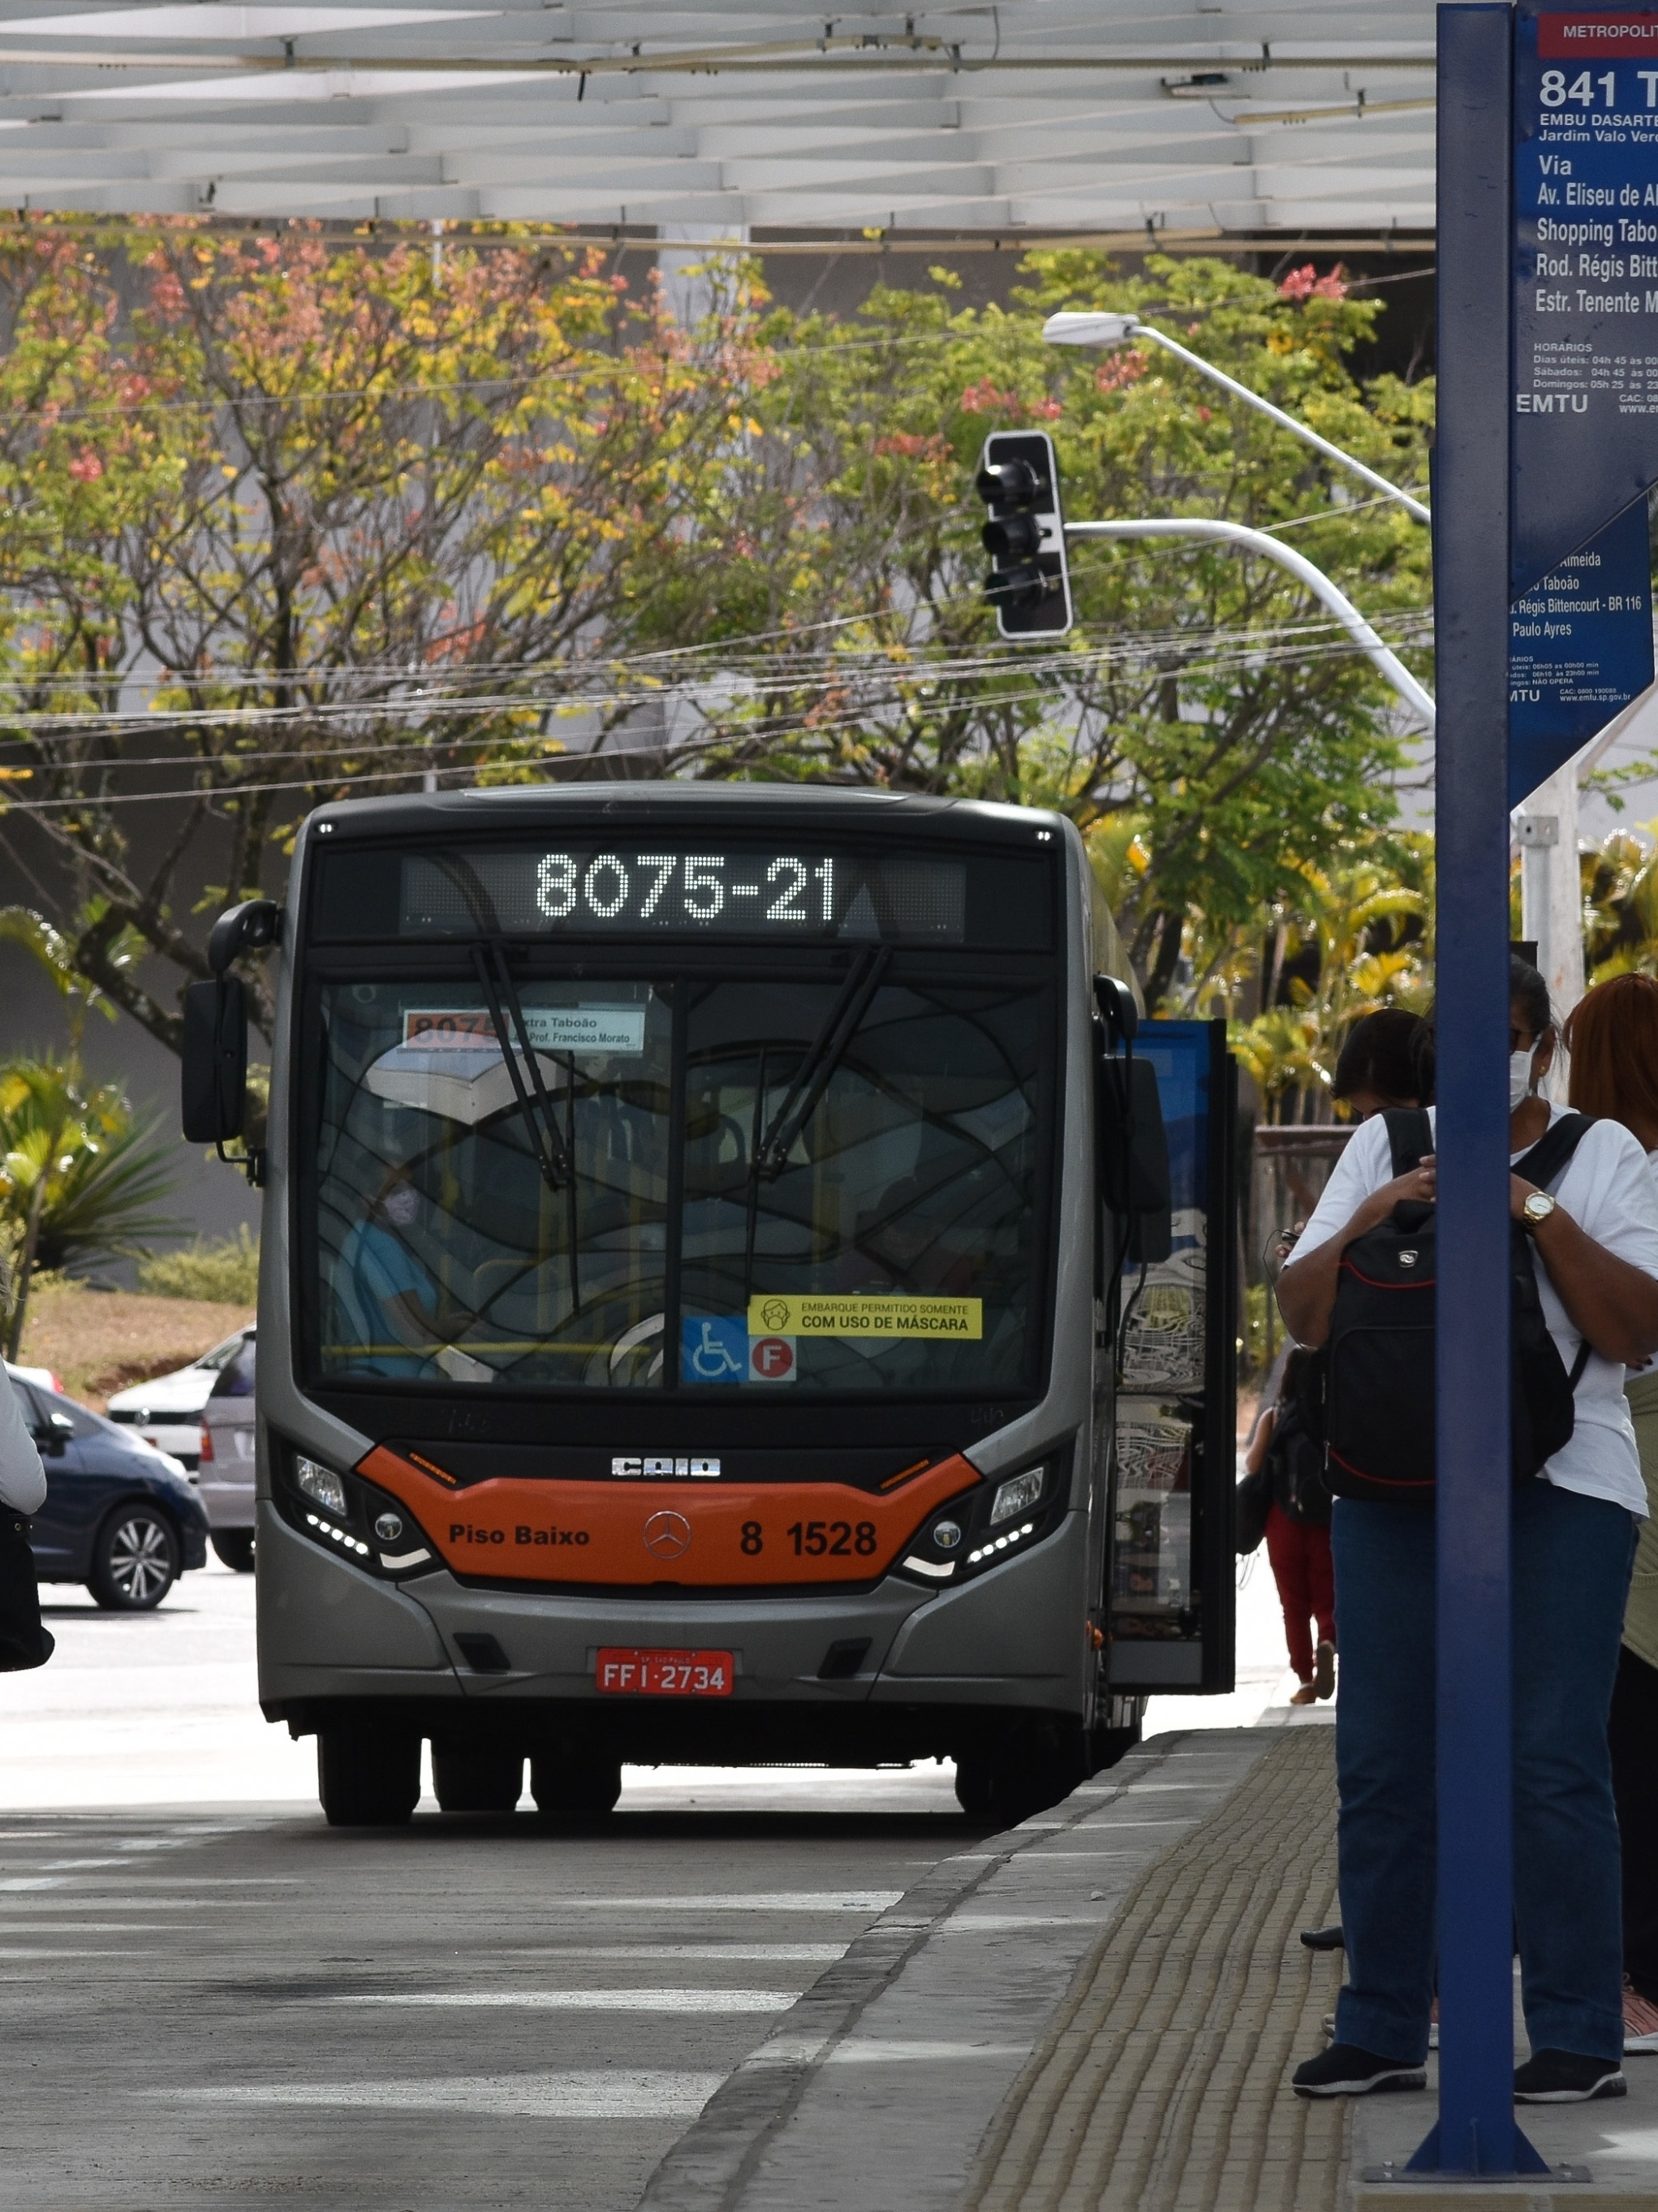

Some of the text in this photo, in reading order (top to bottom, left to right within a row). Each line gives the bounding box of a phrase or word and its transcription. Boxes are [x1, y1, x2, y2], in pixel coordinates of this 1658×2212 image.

[1540, 70, 1615, 107] 841
[1540, 114, 1586, 126] EMBU
[1539, 130, 1590, 141] Jardim
[1595, 130, 1626, 142] Valo
[1539, 155, 1571, 175] Via
[1537, 182, 1560, 205] Av.
[1566, 183, 1614, 205] Eliseu
[1620, 183, 1639, 206] de
[1537, 217, 1658, 247] Shopping Tabo
[1536, 253, 1658, 282] Rod. Régis Bitt
[1535, 289, 1571, 312] Estr.
[1576, 289, 1640, 313] Tenente
[1533, 355, 1557, 364] Dias
[1613, 356, 1626, 364] 45
[1644, 356, 1658, 365] 00
[1613, 369, 1625, 377] 45
[1533, 379, 1588, 390] Domingos:
[1611, 380, 1624, 390] 25
[1516, 394, 1588, 413] EMTU
[1544, 575, 1579, 590] Taboão
[1519, 598, 1546, 617] Régis
[1548, 597, 1600, 613] Bittencourt
[1608, 596, 1623, 610] BR
[1626, 595, 1642, 610] 116
[1513, 621, 1572, 639] Paulo Ayres
[536, 853, 833, 921] 8075-21
[551, 1017, 597, 1028] Taboão
[529, 1033, 550, 1043] Prof.
[553, 1033, 596, 1042] Francisco
[598, 1033, 630, 1042] Morato
[801, 1302, 969, 1315] EMBARQUE PERMITIDO SOMENTE
[802, 1315, 968, 1330] COM USO DE MÁSCARA
[762, 1344, 782, 1370] F
[450, 1524, 590, 1546] Piso Baixo
[739, 1520, 877, 1556] 8 1528
